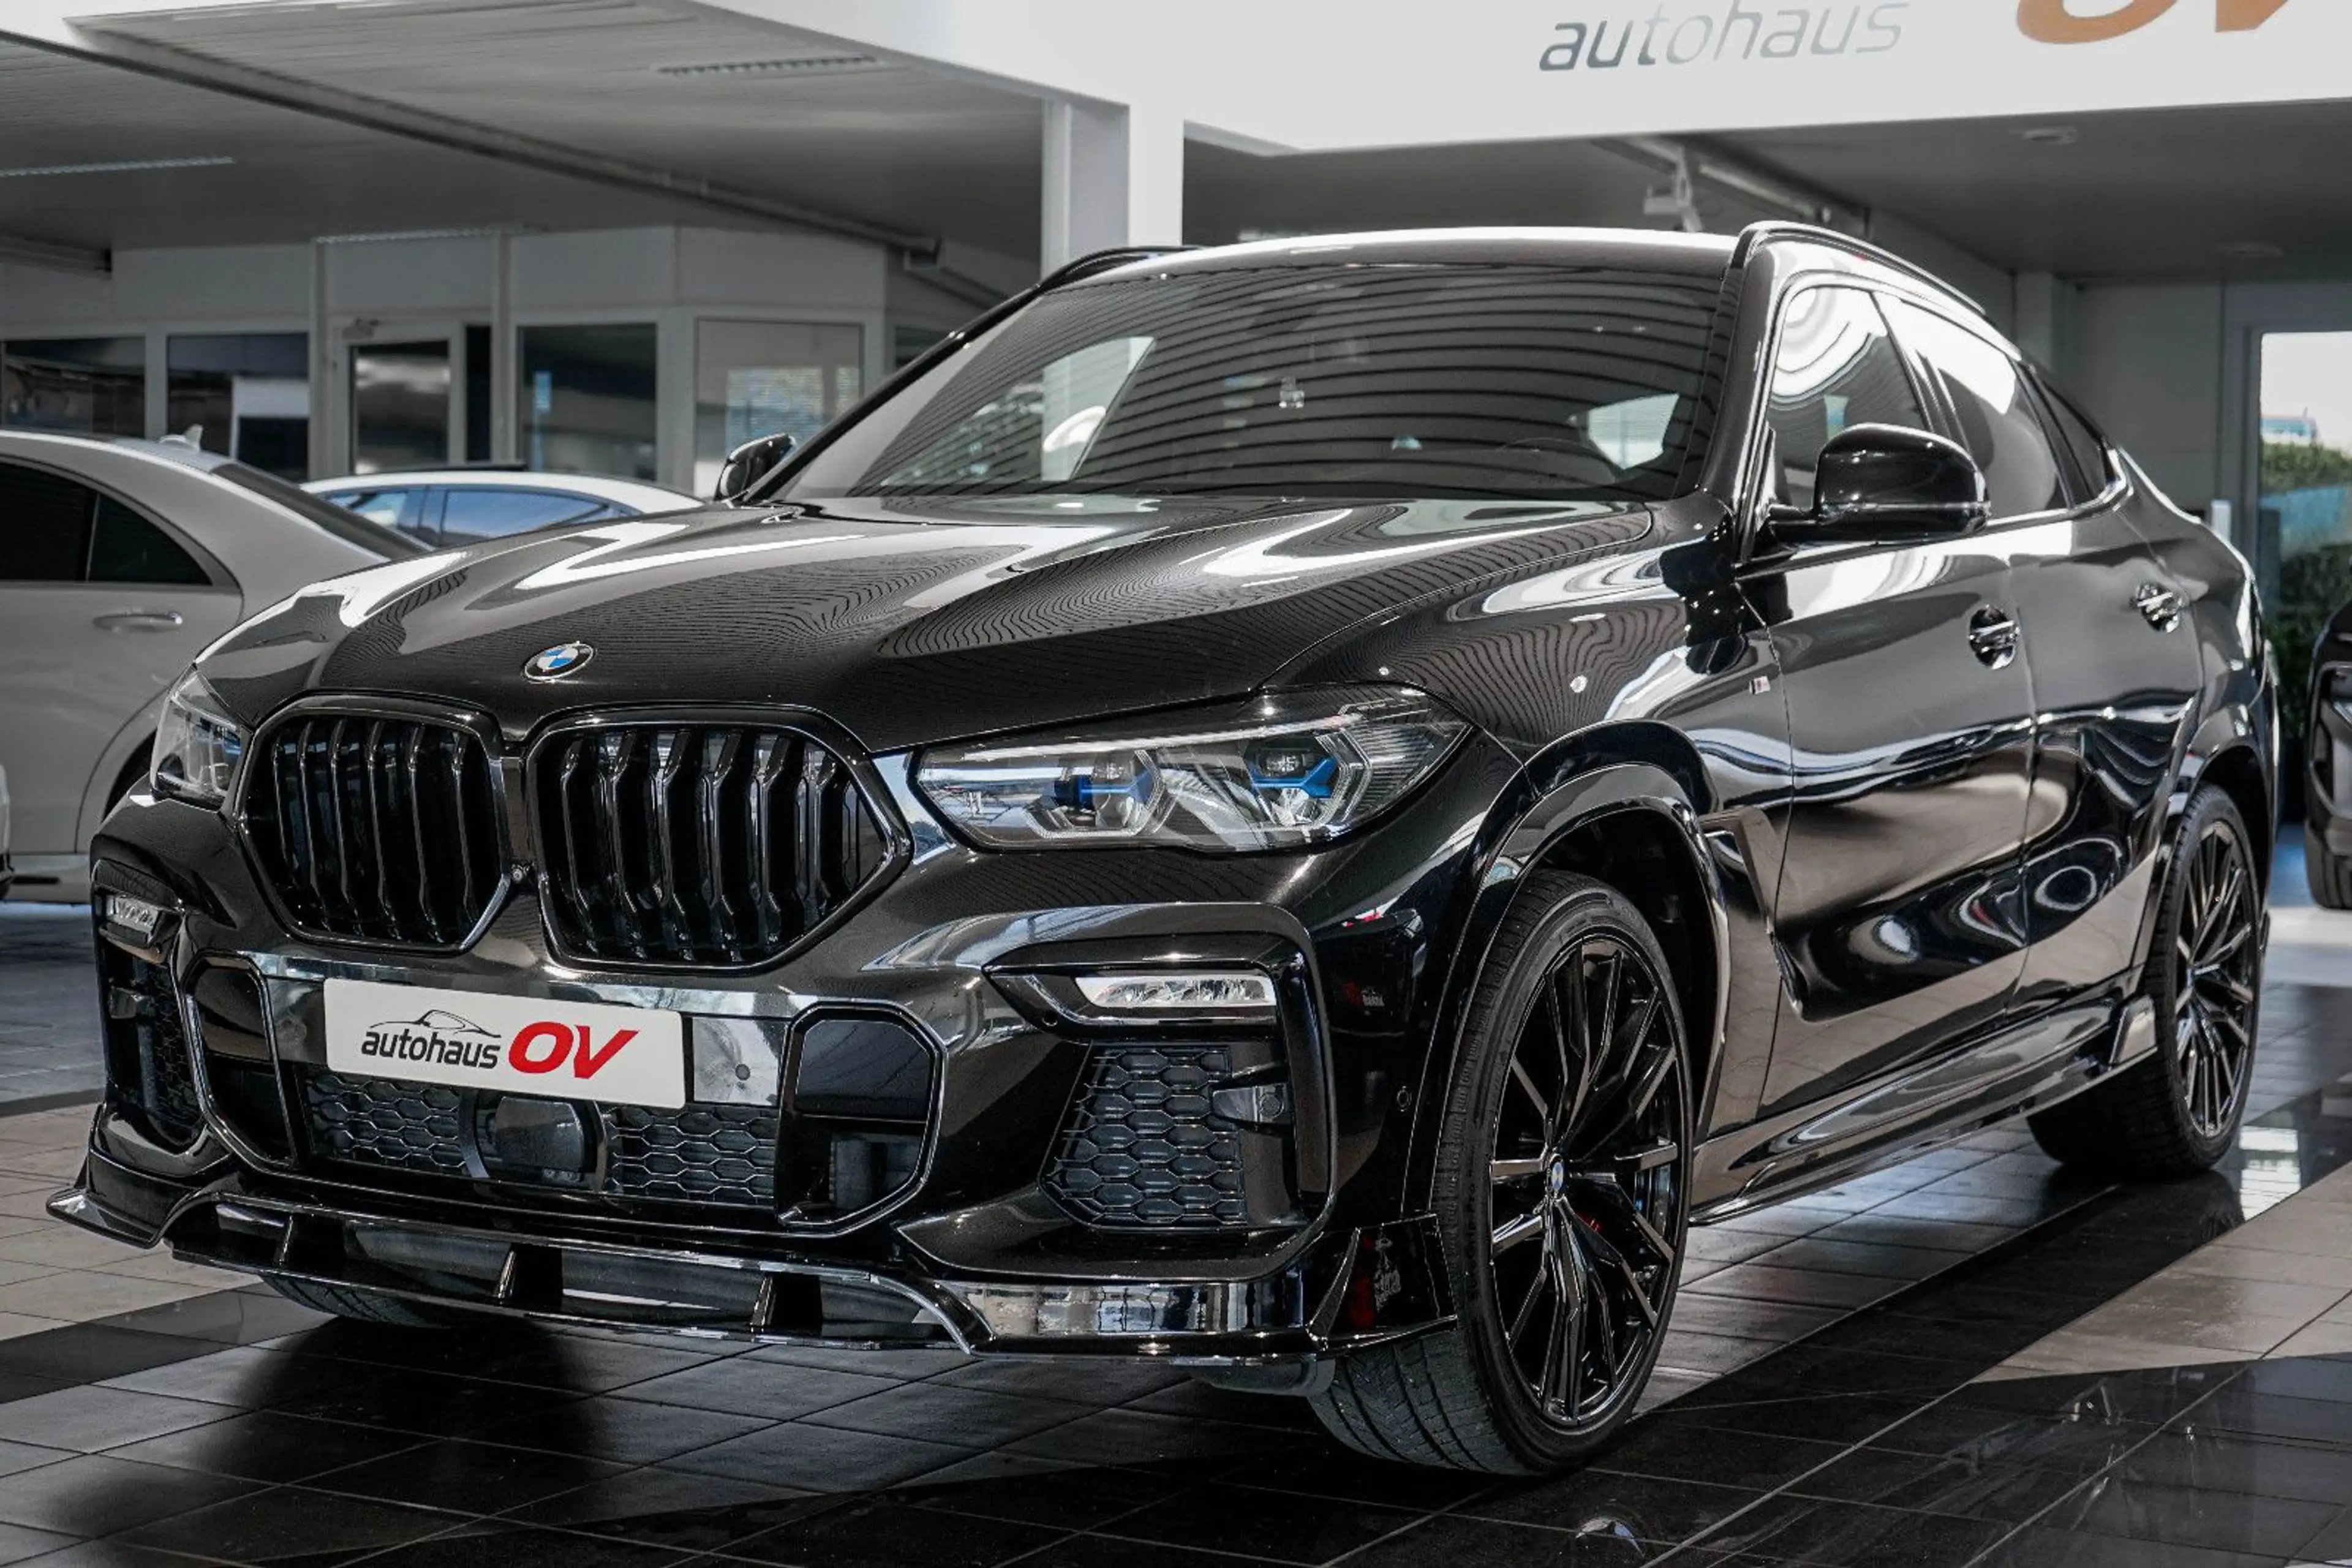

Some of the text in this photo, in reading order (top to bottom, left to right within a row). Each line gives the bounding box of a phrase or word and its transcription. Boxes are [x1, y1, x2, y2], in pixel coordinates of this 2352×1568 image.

[1539, 0, 1909, 71] autohaus
[361, 1021, 639, 1079] autohaus OV
